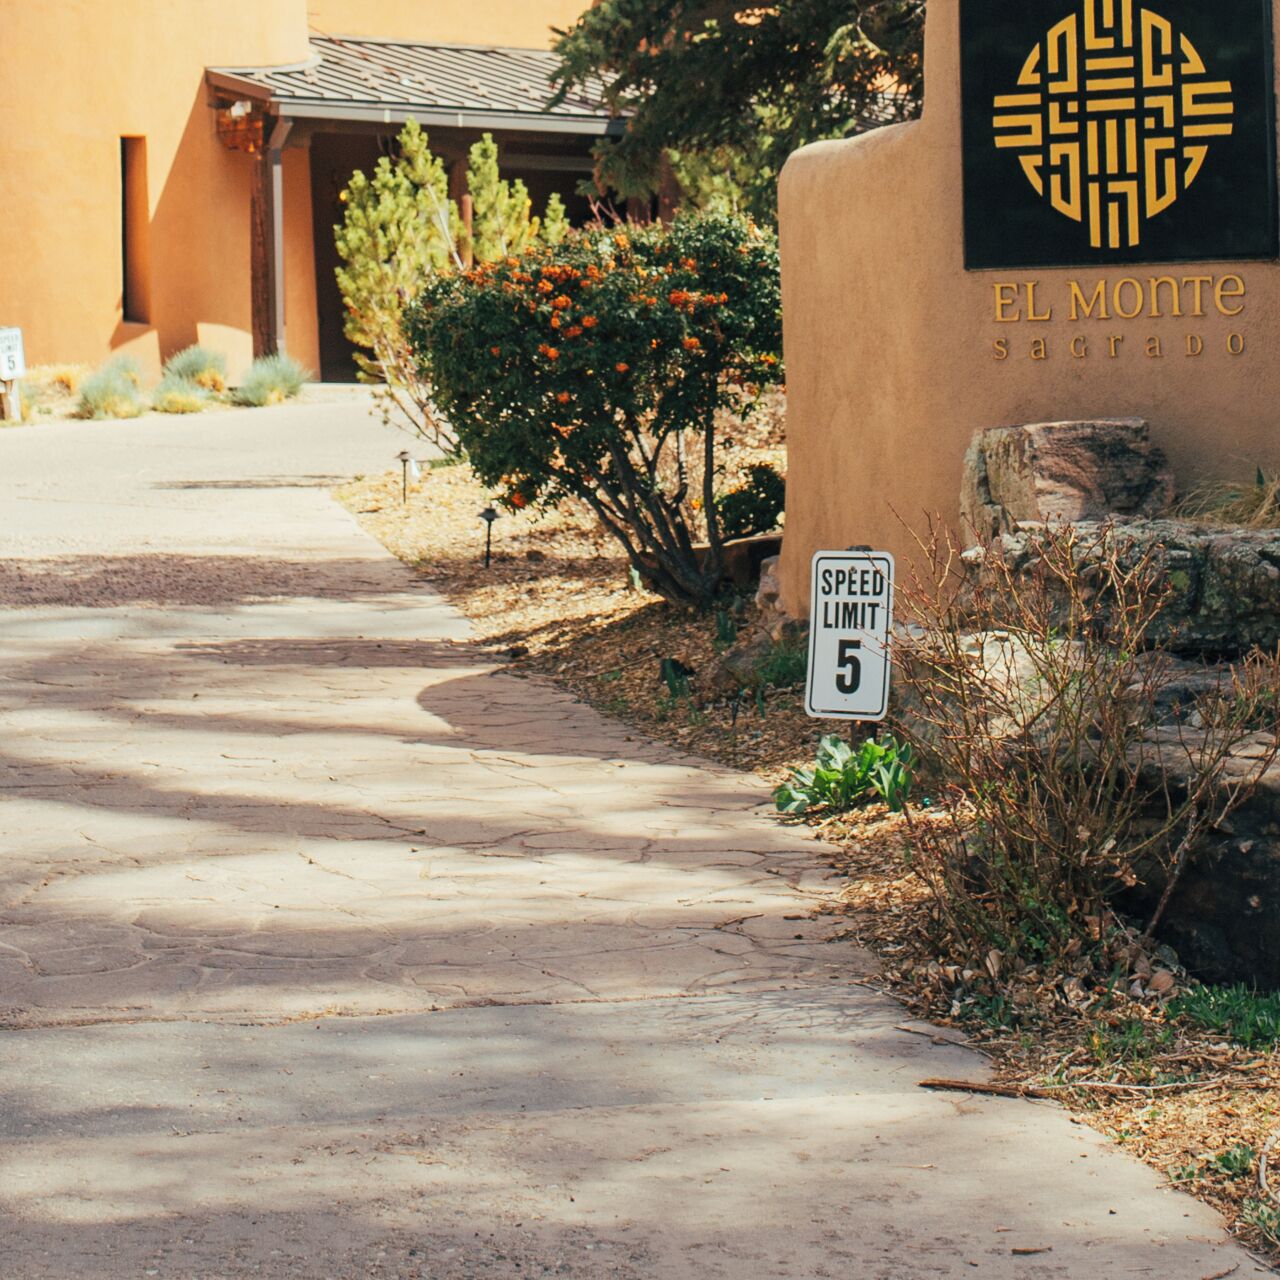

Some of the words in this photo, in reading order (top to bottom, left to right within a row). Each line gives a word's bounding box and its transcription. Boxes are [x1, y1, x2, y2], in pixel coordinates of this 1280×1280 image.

[992, 280, 1052, 322] EL
[7, 355, 15, 370] 5
[821, 568, 884, 597] SPEED
[823, 601, 880, 630] LIMIT
[835, 638, 862, 695] 5
